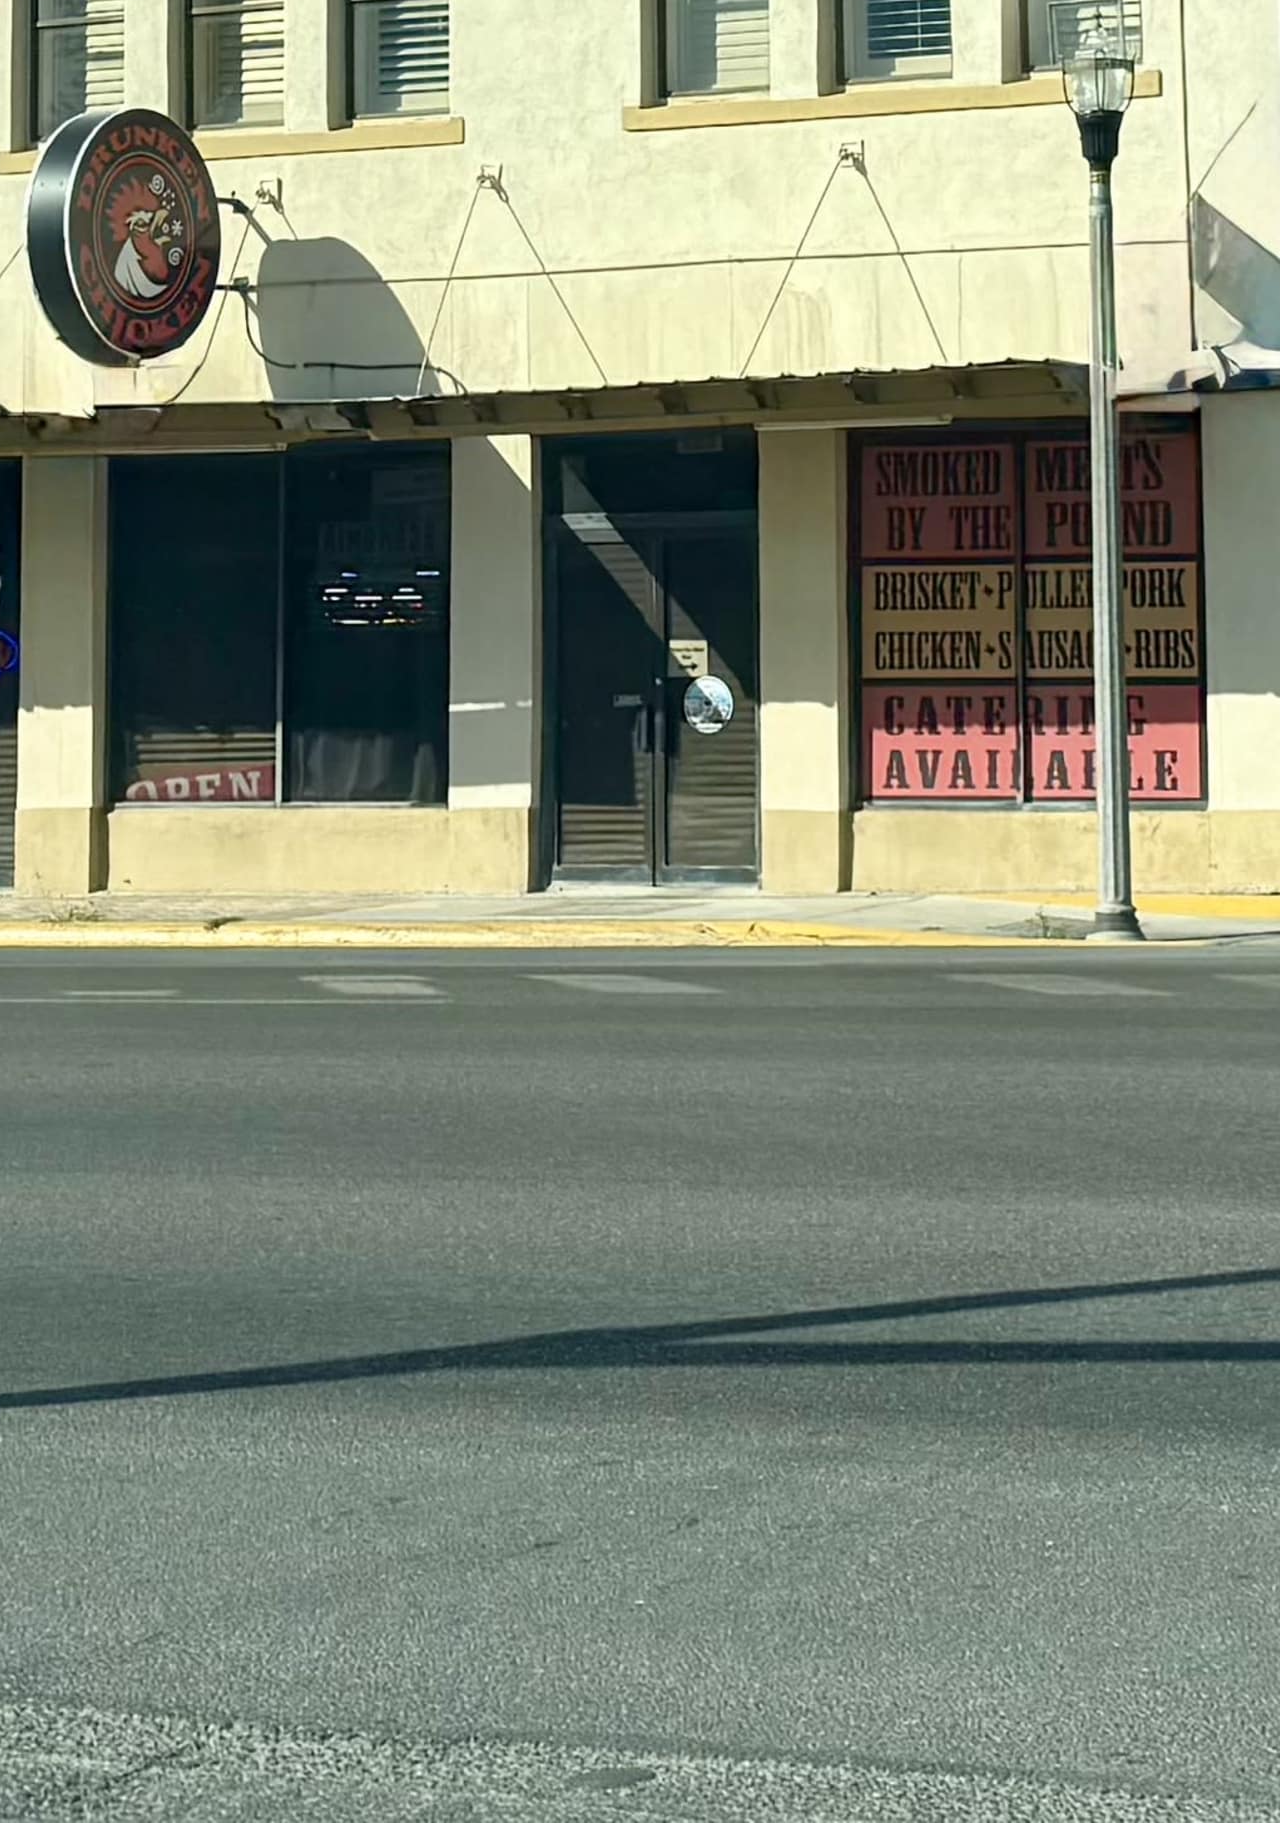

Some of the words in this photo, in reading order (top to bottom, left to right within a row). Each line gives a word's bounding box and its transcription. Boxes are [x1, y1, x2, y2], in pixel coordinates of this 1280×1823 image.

[875, 448, 1002, 496] SMOKED
[1035, 440, 1164, 493] METS
[886, 506, 927, 551] BY
[949, 504, 1011, 551] THE
[1046, 500, 1172, 548] POND
[873, 570, 980, 610] BRISKET
[997, 567, 1093, 610] PULLE
[1123, 567, 1186, 608] ORK
[874, 631, 981, 670] CHICKEN
[998, 629, 1094, 669] SAUSA
[1134, 629, 1195, 669] RIBS
[126, 770, 261, 800] OPEN
